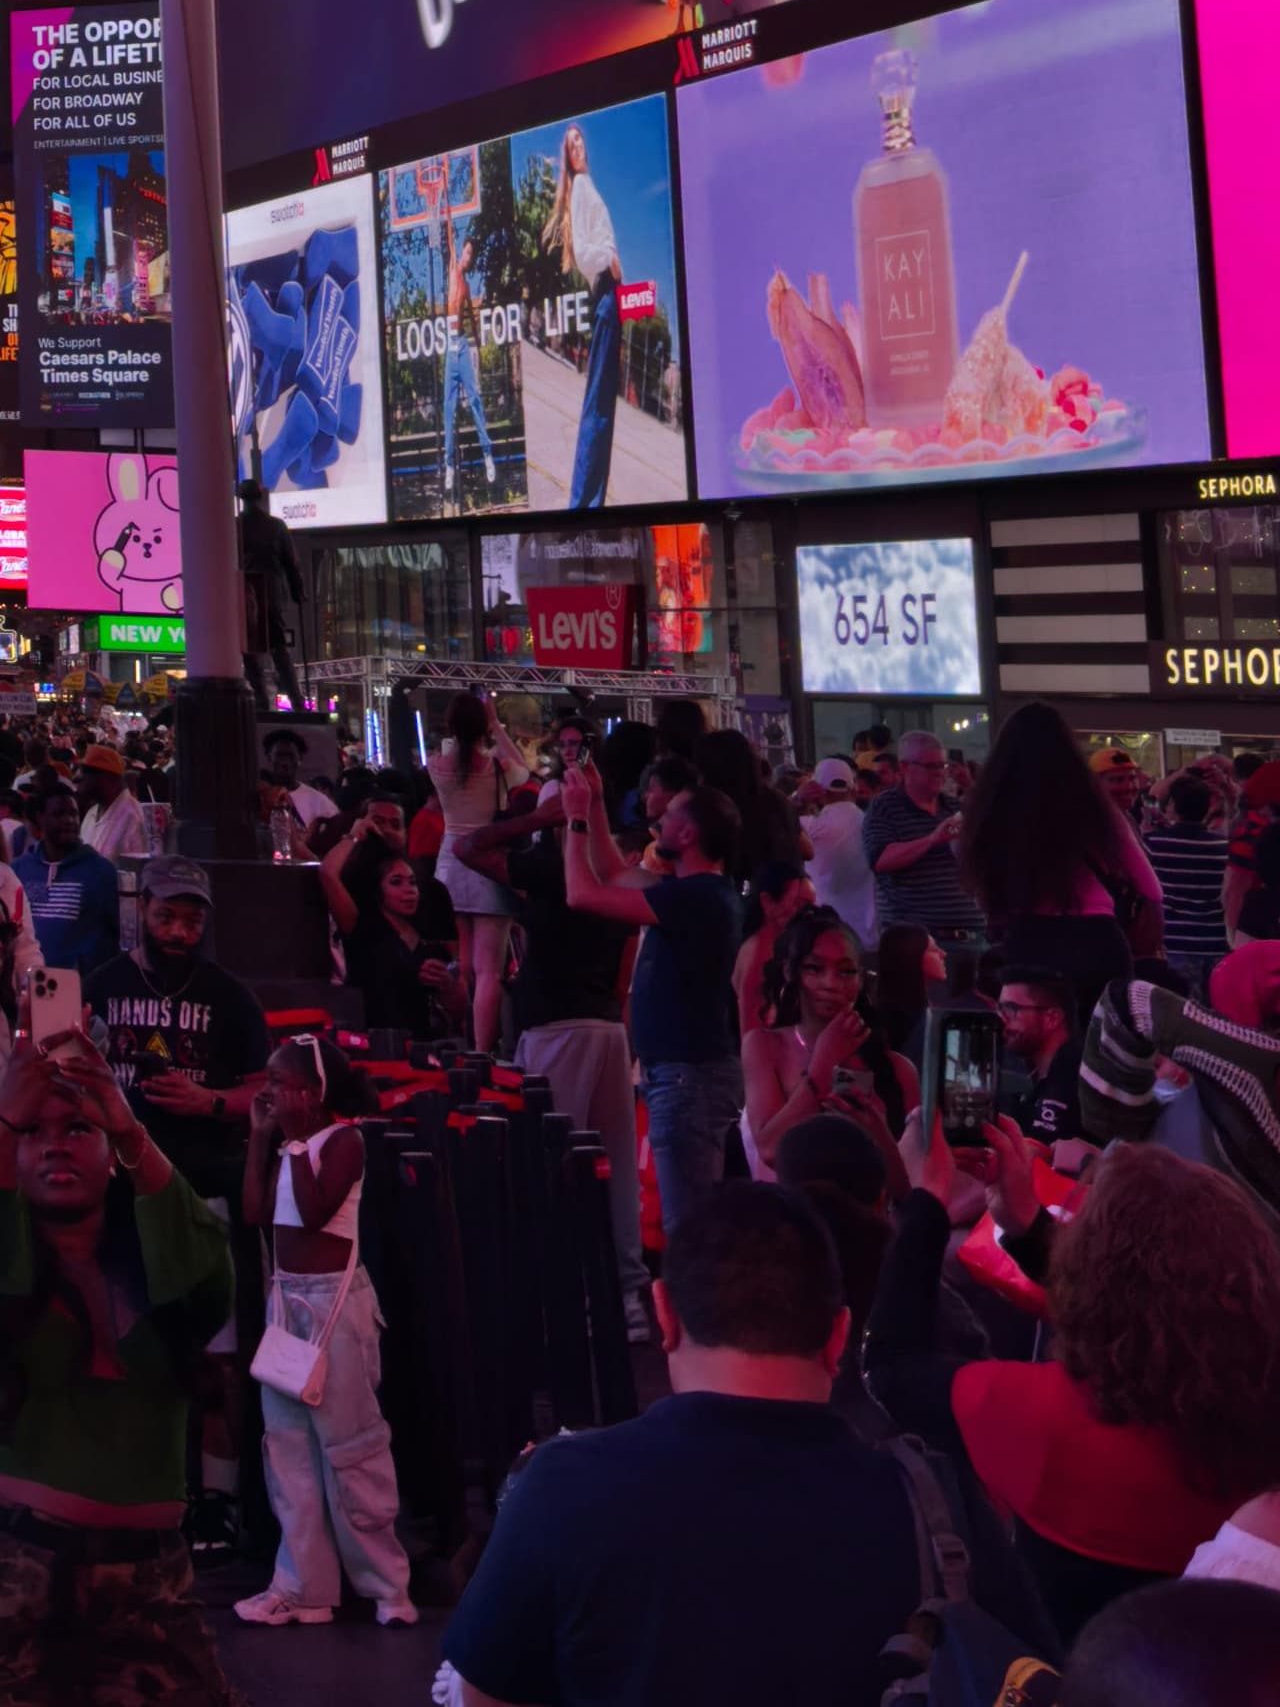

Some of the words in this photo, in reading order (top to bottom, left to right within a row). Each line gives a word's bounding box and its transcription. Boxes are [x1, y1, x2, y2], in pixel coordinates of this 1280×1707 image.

[32, 23, 79, 47] THE
[702, 19, 759, 49] MARRIOTT
[32, 47, 65, 72] OF
[69, 46, 88, 68] A
[703, 42, 754, 70] MARQUIS
[32, 77, 62, 91] FOR
[64, 74, 111, 89] LOCAL
[32, 96, 61, 111] FOR
[64, 92, 144, 109] BROADWAY
[33, 117, 61, 131] FOR
[64, 115, 86, 130] ALL
[88, 114, 112, 128] OF
[115, 113, 137, 127] US
[33, 137, 102, 149] ENTERTAINMENT
[107, 136, 126, 146] LIVE
[331, 136, 370, 158] MARRIOTT
[332, 155, 366, 176] MARQUIS
[883, 248, 925, 282] KAY
[887, 290, 924, 322] ALI
[396, 314, 460, 362] LOOSE
[479, 303, 523, 347] FOR
[543, 290, 590, 337] LIFE
[38, 338, 56, 350] We
[58, 336, 101, 352] Support
[39, 351, 106, 367] Caesars
[107, 349, 162, 365] Palace
[40, 369, 90, 384] Times
[91, 368, 150, 388] Square
[1199, 474, 1276, 500] SEPHORA
[834, 594, 890, 646] 654
[901, 592, 937, 645] SF
[109, 623, 165, 644] NEW
[1165, 647, 1280, 686] SEPHO
[107, 997, 172, 1027] HANDS
[179, 1000, 212, 1033] OFF
